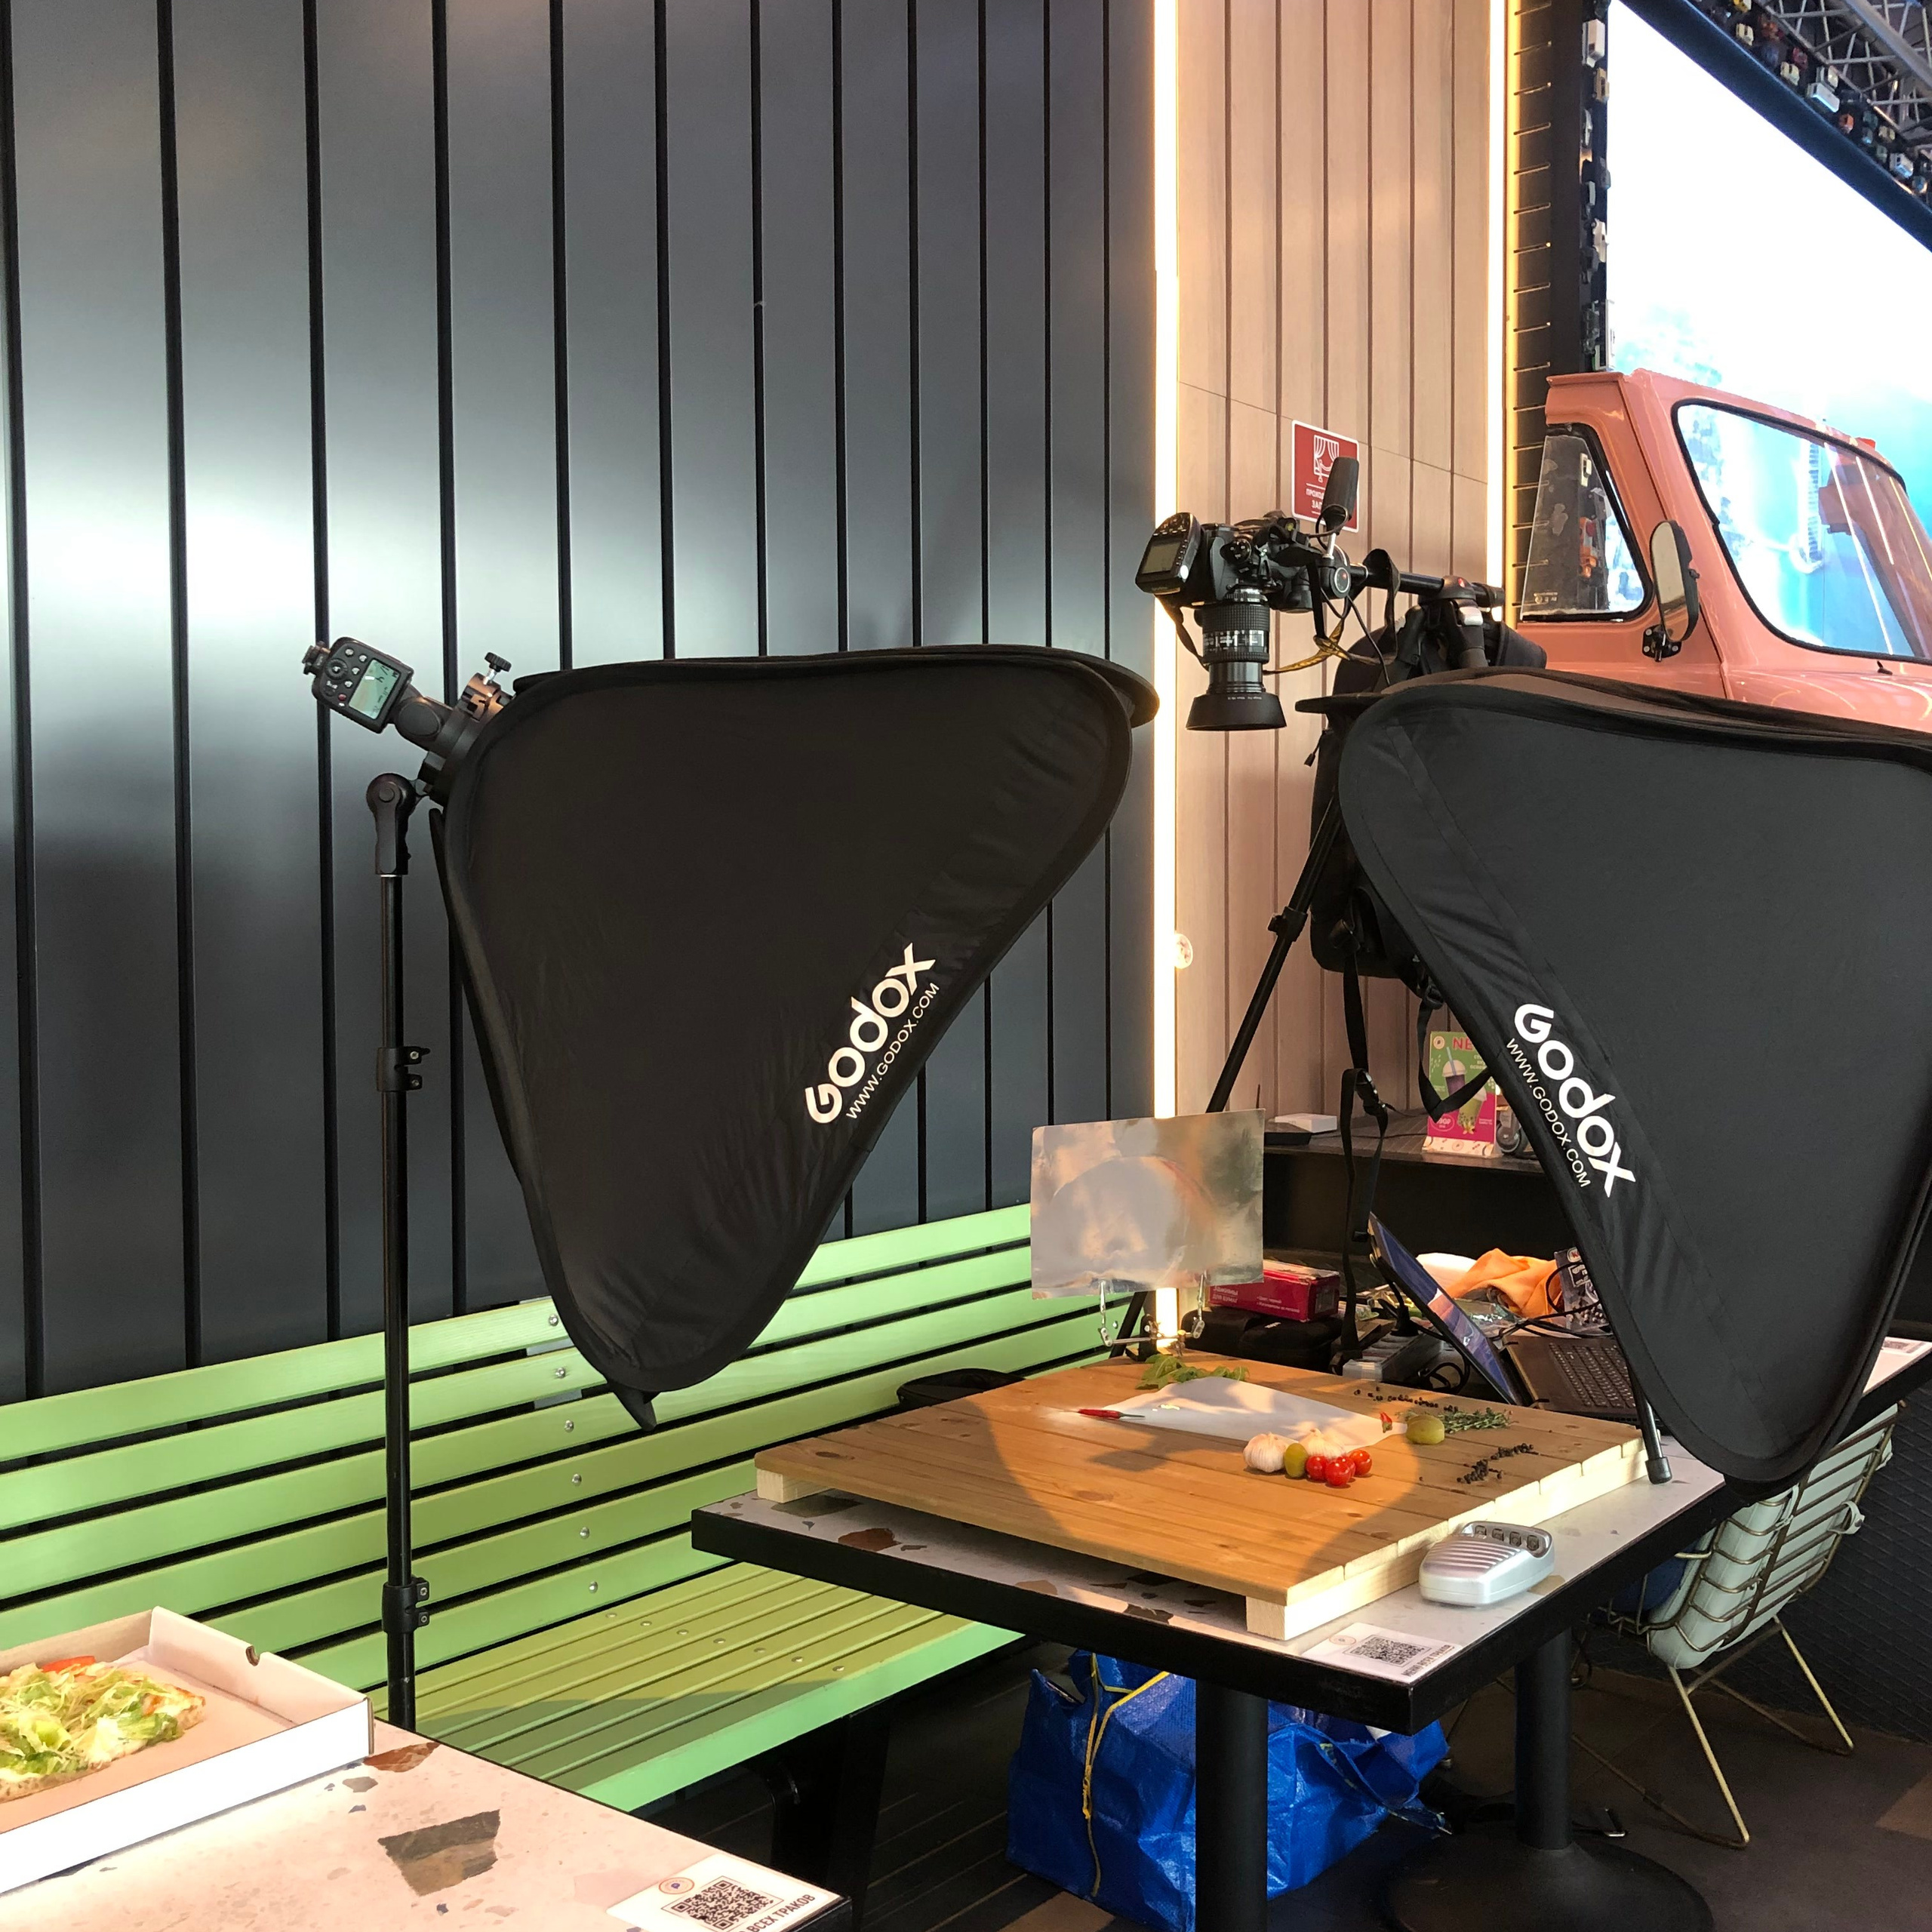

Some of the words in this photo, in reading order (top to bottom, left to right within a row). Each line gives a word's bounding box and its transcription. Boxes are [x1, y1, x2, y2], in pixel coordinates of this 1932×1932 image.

[845, 982, 940, 1119] WWW.GODOX.COM
[1453, 1036, 1474, 1051] NE
[1506, 1038, 1591, 1187] WWW.GODOX.COM
[746, 1915, 779, 1932] ВСЕХ
[772, 1894, 816, 1918] ТРАКОВ
